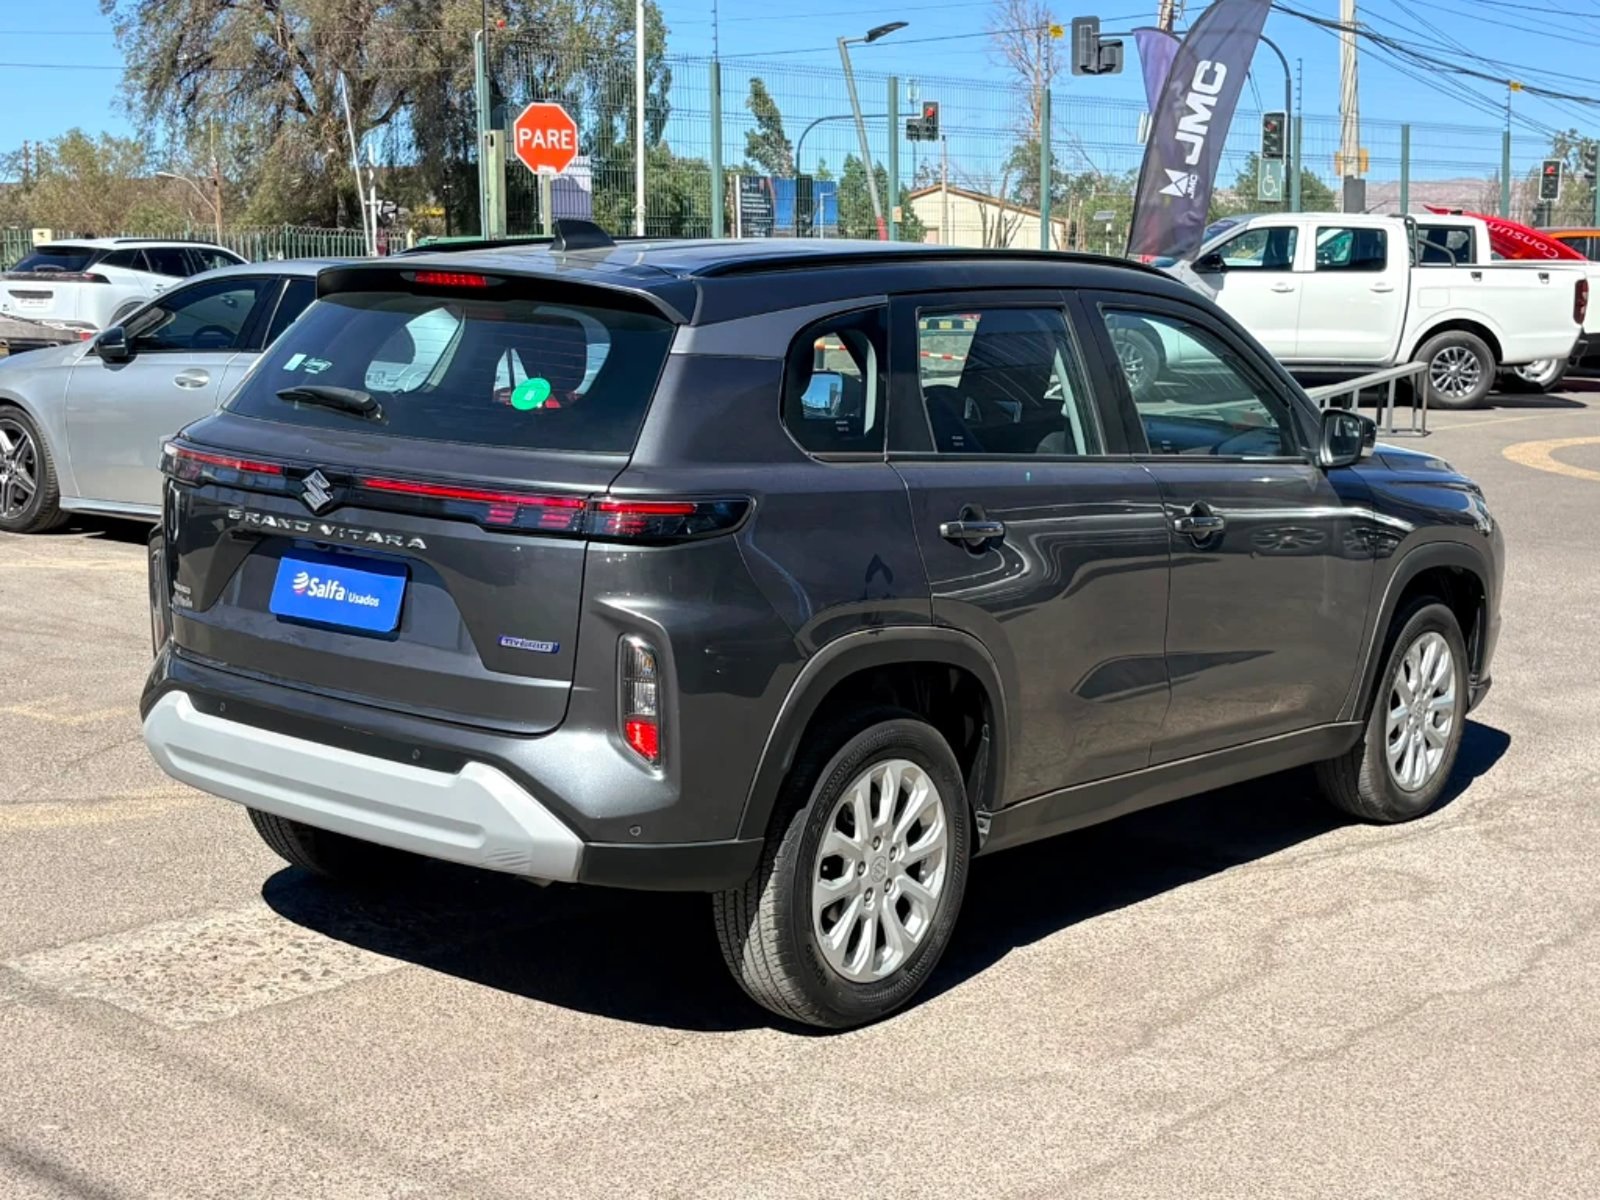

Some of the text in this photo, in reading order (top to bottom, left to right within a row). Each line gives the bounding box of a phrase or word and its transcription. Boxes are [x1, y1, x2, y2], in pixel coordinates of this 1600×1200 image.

[1175, 59, 1227, 166] JMC
[518, 128, 573, 150] PARE
[1188, 174, 1199, 200] JMC
[228, 508, 427, 550] GRAND VITARA
[307, 577, 380, 608] Salfa Usados
